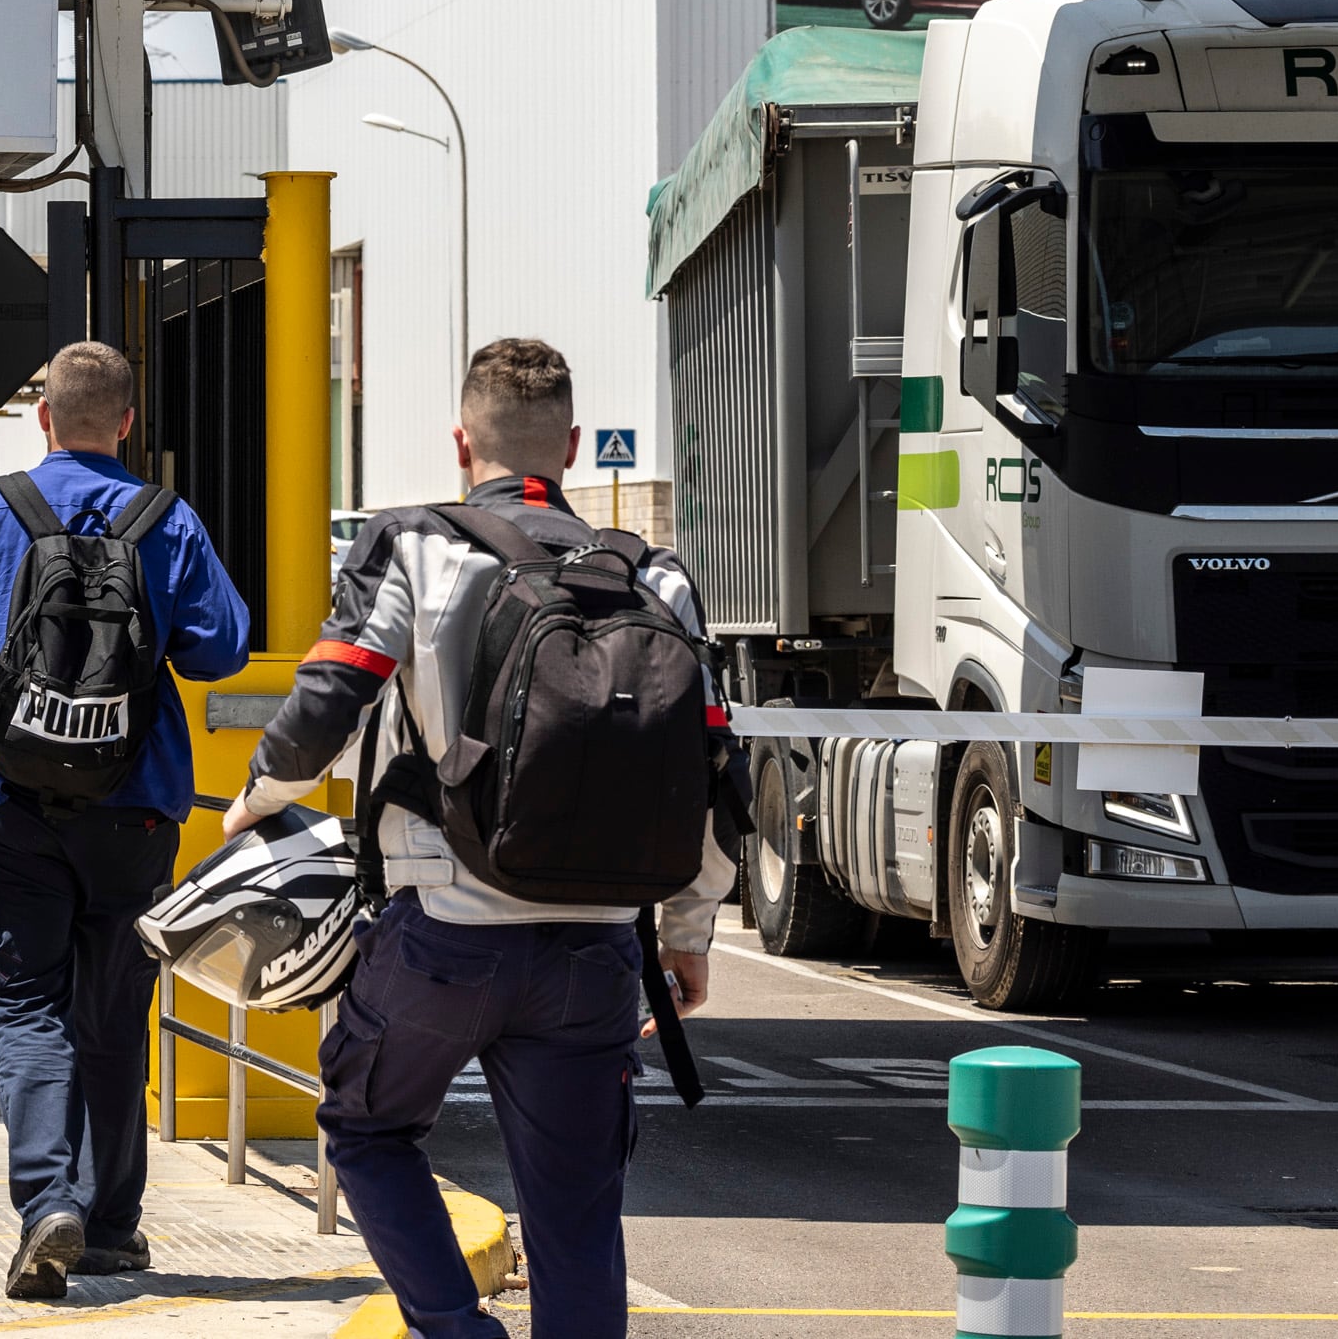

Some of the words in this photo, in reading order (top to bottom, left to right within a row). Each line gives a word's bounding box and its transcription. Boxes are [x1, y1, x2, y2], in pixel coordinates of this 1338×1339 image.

[986, 457, 1043, 503] ROS
[1022, 512, 1041, 532] Group
[1188, 558, 1271, 571] VOLVO
[22, 689, 124, 739] PUMA
[261, 884, 356, 989] SCORPION
